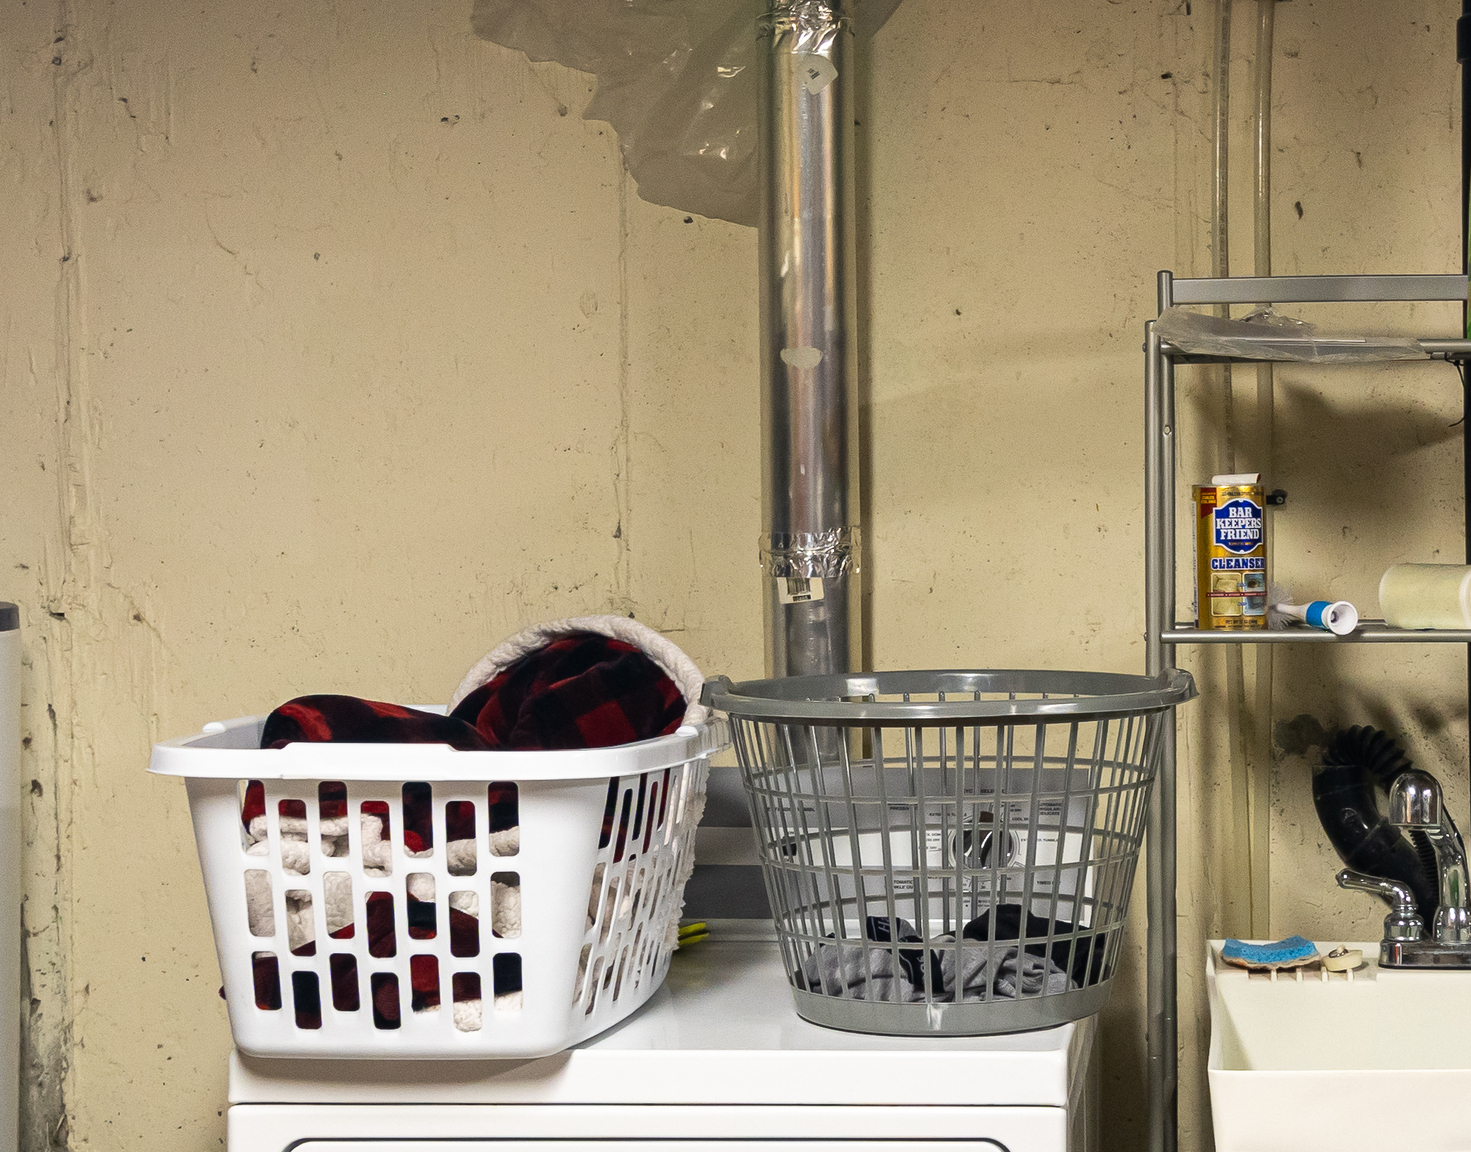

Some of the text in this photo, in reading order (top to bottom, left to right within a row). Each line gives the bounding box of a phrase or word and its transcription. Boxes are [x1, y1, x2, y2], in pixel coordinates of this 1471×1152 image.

[1229, 507, 1252, 518] BAR
[1216, 518, 1262, 528] KEEPERS
[1220, 529, 1259, 540] FRIEND
[1212, 558, 1265, 569] CLEANSER
